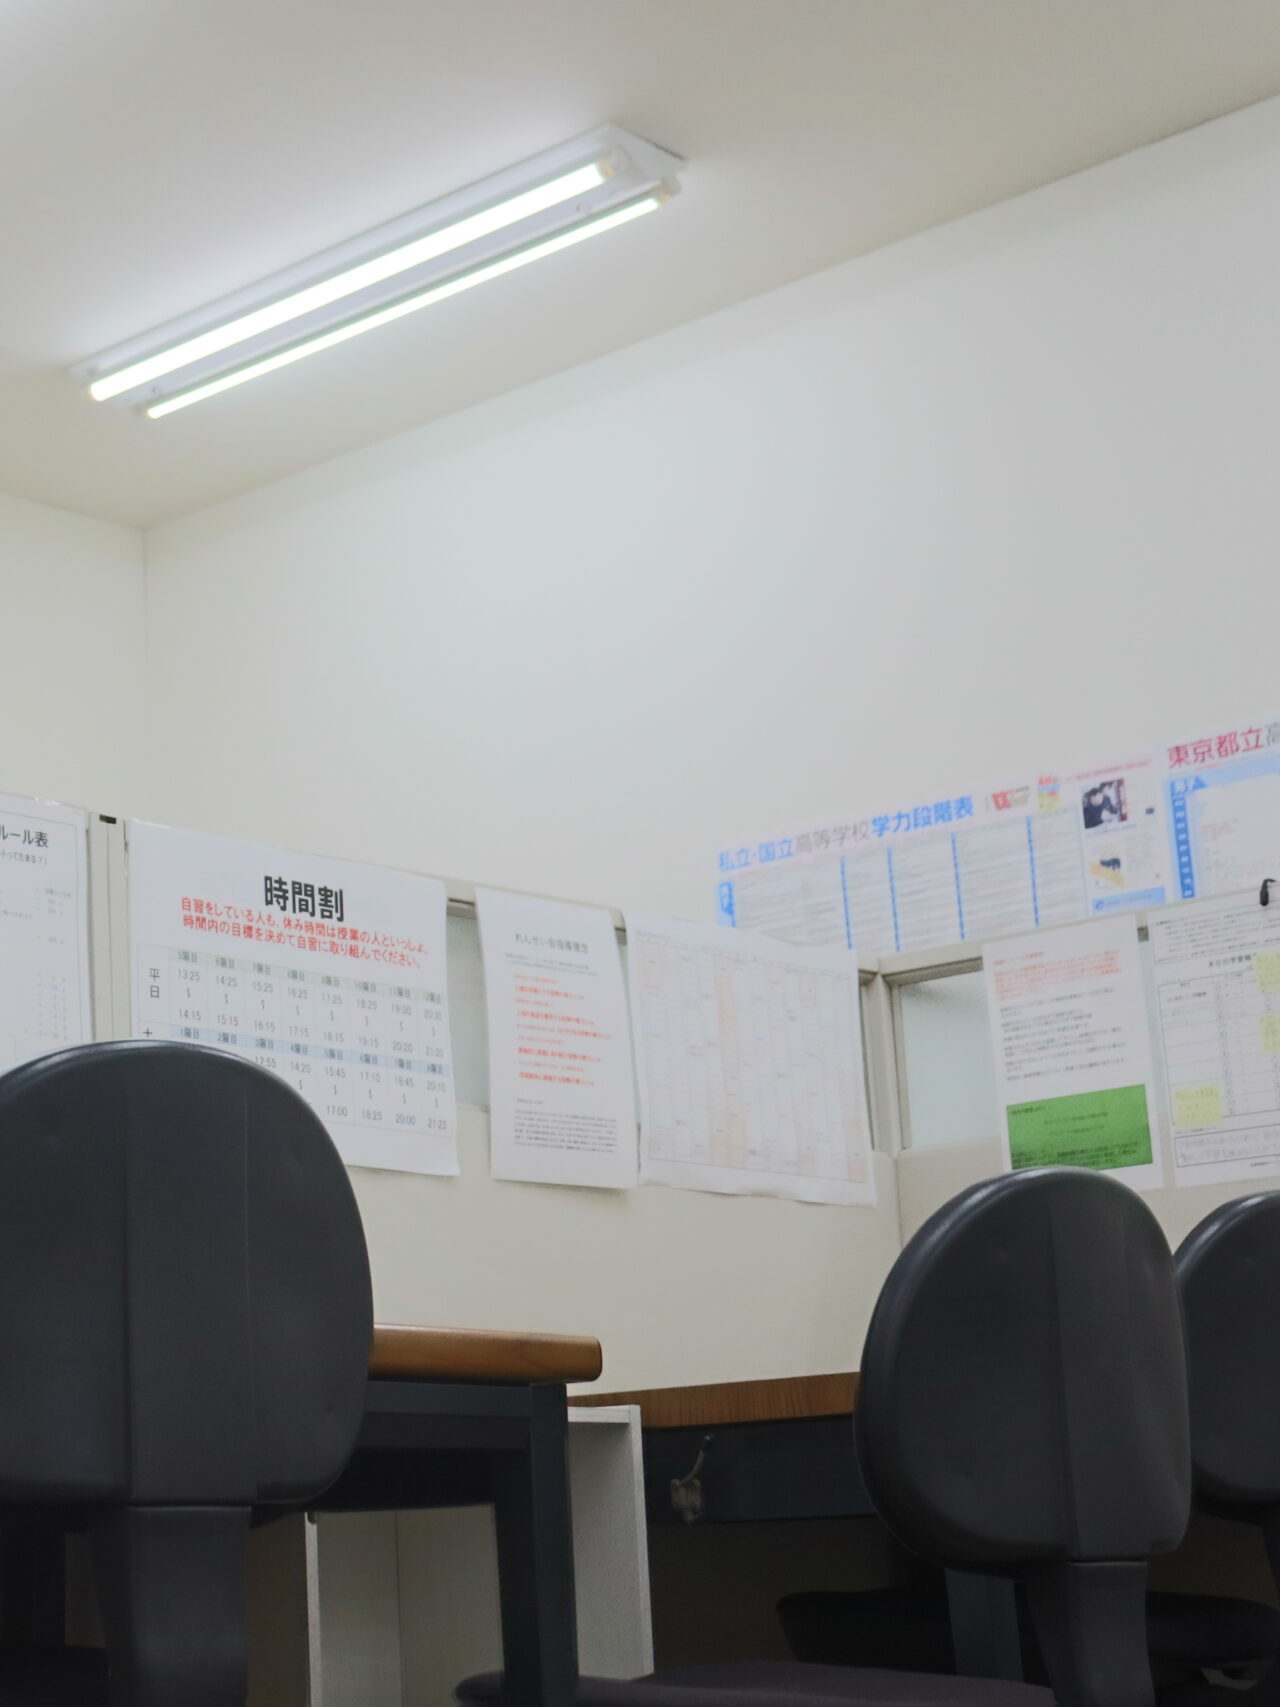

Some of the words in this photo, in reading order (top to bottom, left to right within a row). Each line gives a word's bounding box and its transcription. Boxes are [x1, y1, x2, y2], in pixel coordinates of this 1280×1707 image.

[264, 876, 344, 922] 時間割
[178, 969, 200, 982] 13:25
[216, 975, 238, 988] 14:25
[253, 981, 274, 994] 15:25
[288, 987, 308, 1000] 16:25
[179, 1008, 201, 1021] 14:15
[217, 1015, 239, 1027] 15:15
[254, 1020, 275, 1032] 16:15
[289, 1026, 309, 1038] 17:15
[291, 1062, 311, 1074] 14:20
[325, 1066, 346, 1078] 15:45
[326, 1105, 348, 1117] 17:00
